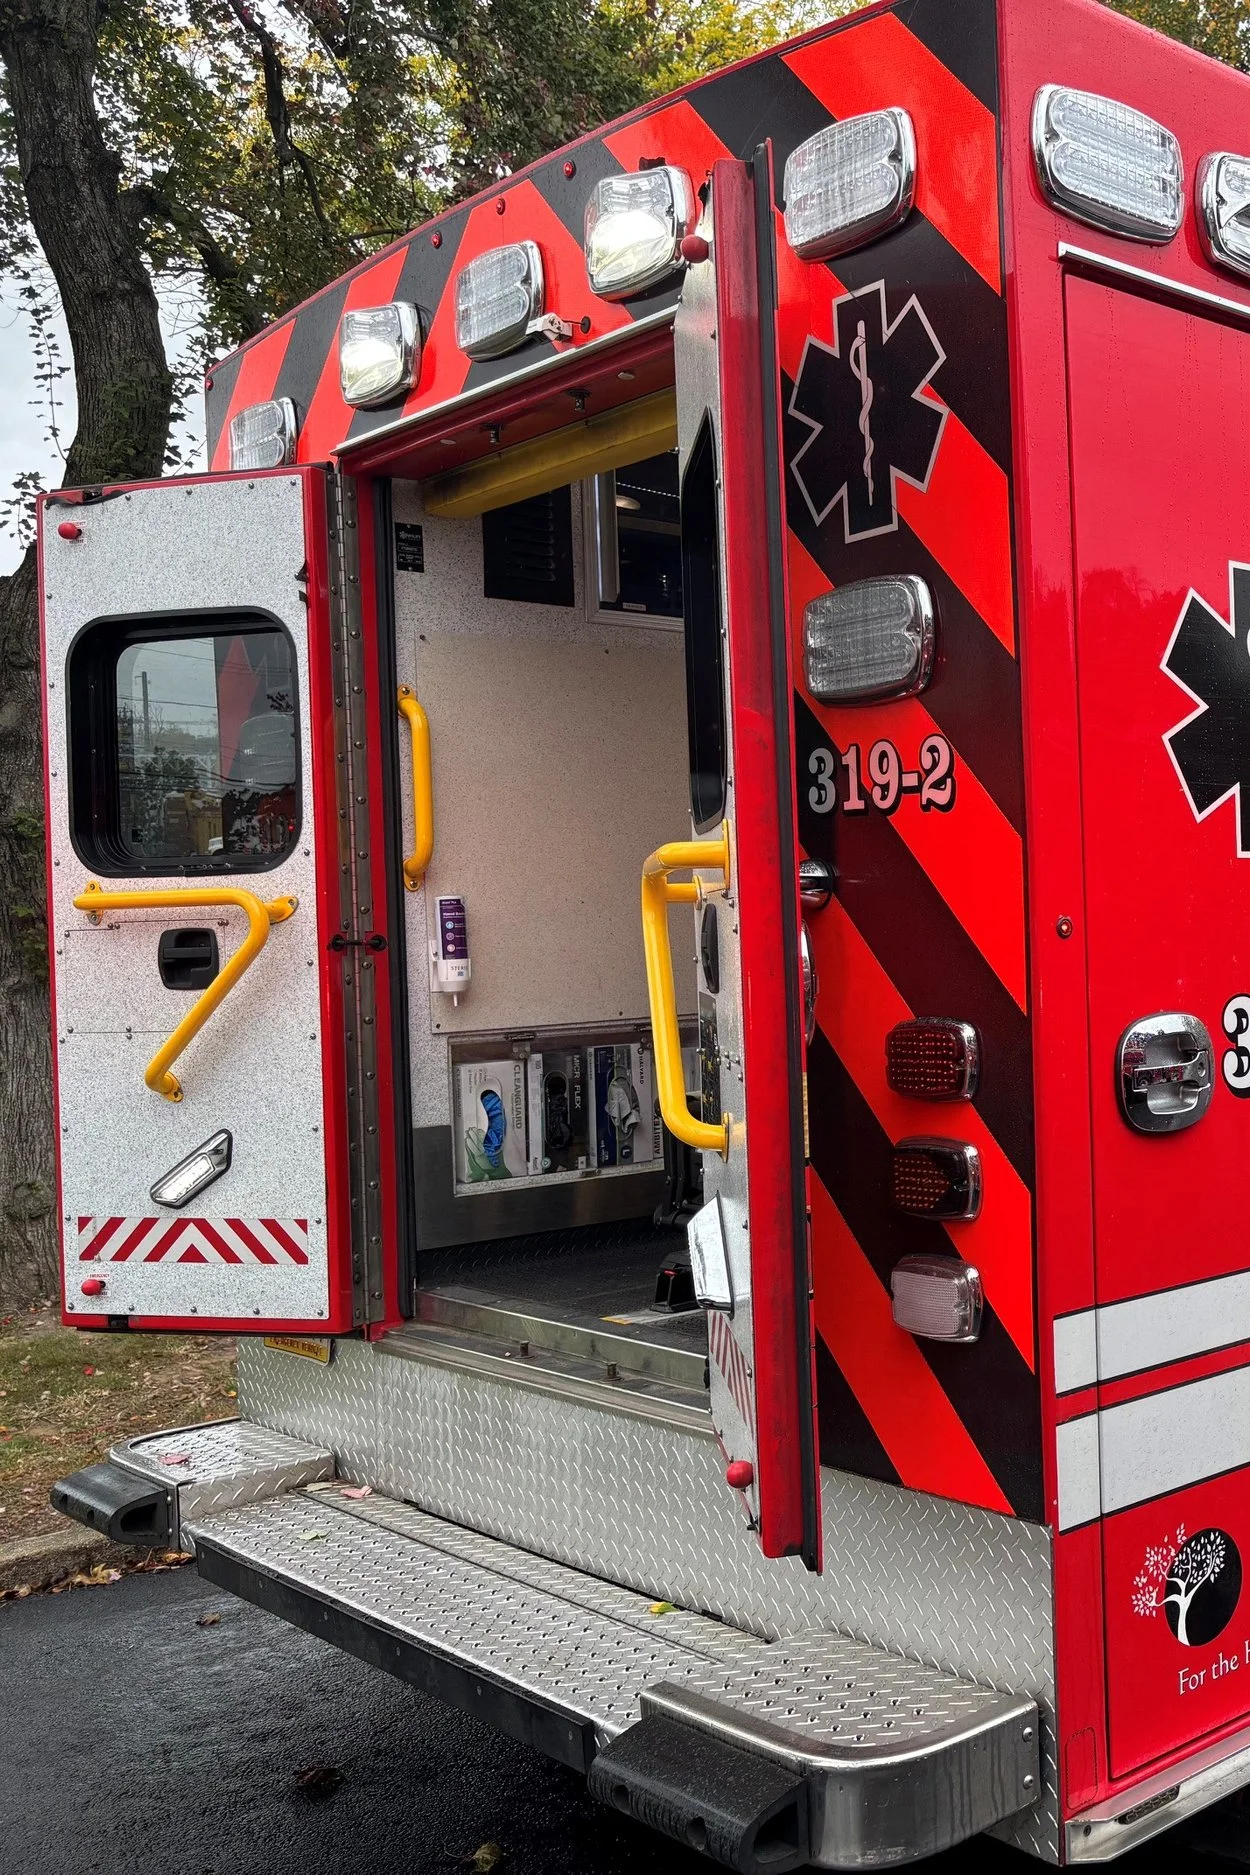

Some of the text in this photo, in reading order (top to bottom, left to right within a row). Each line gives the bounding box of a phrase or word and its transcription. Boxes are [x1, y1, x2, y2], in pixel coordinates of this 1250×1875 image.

[808, 732, 957, 817] 319-2
[513, 1064, 523, 1129] CLEANGUARD
[1178, 1667, 1206, 1696] For
[1211, 1652, 1240, 1674] the
